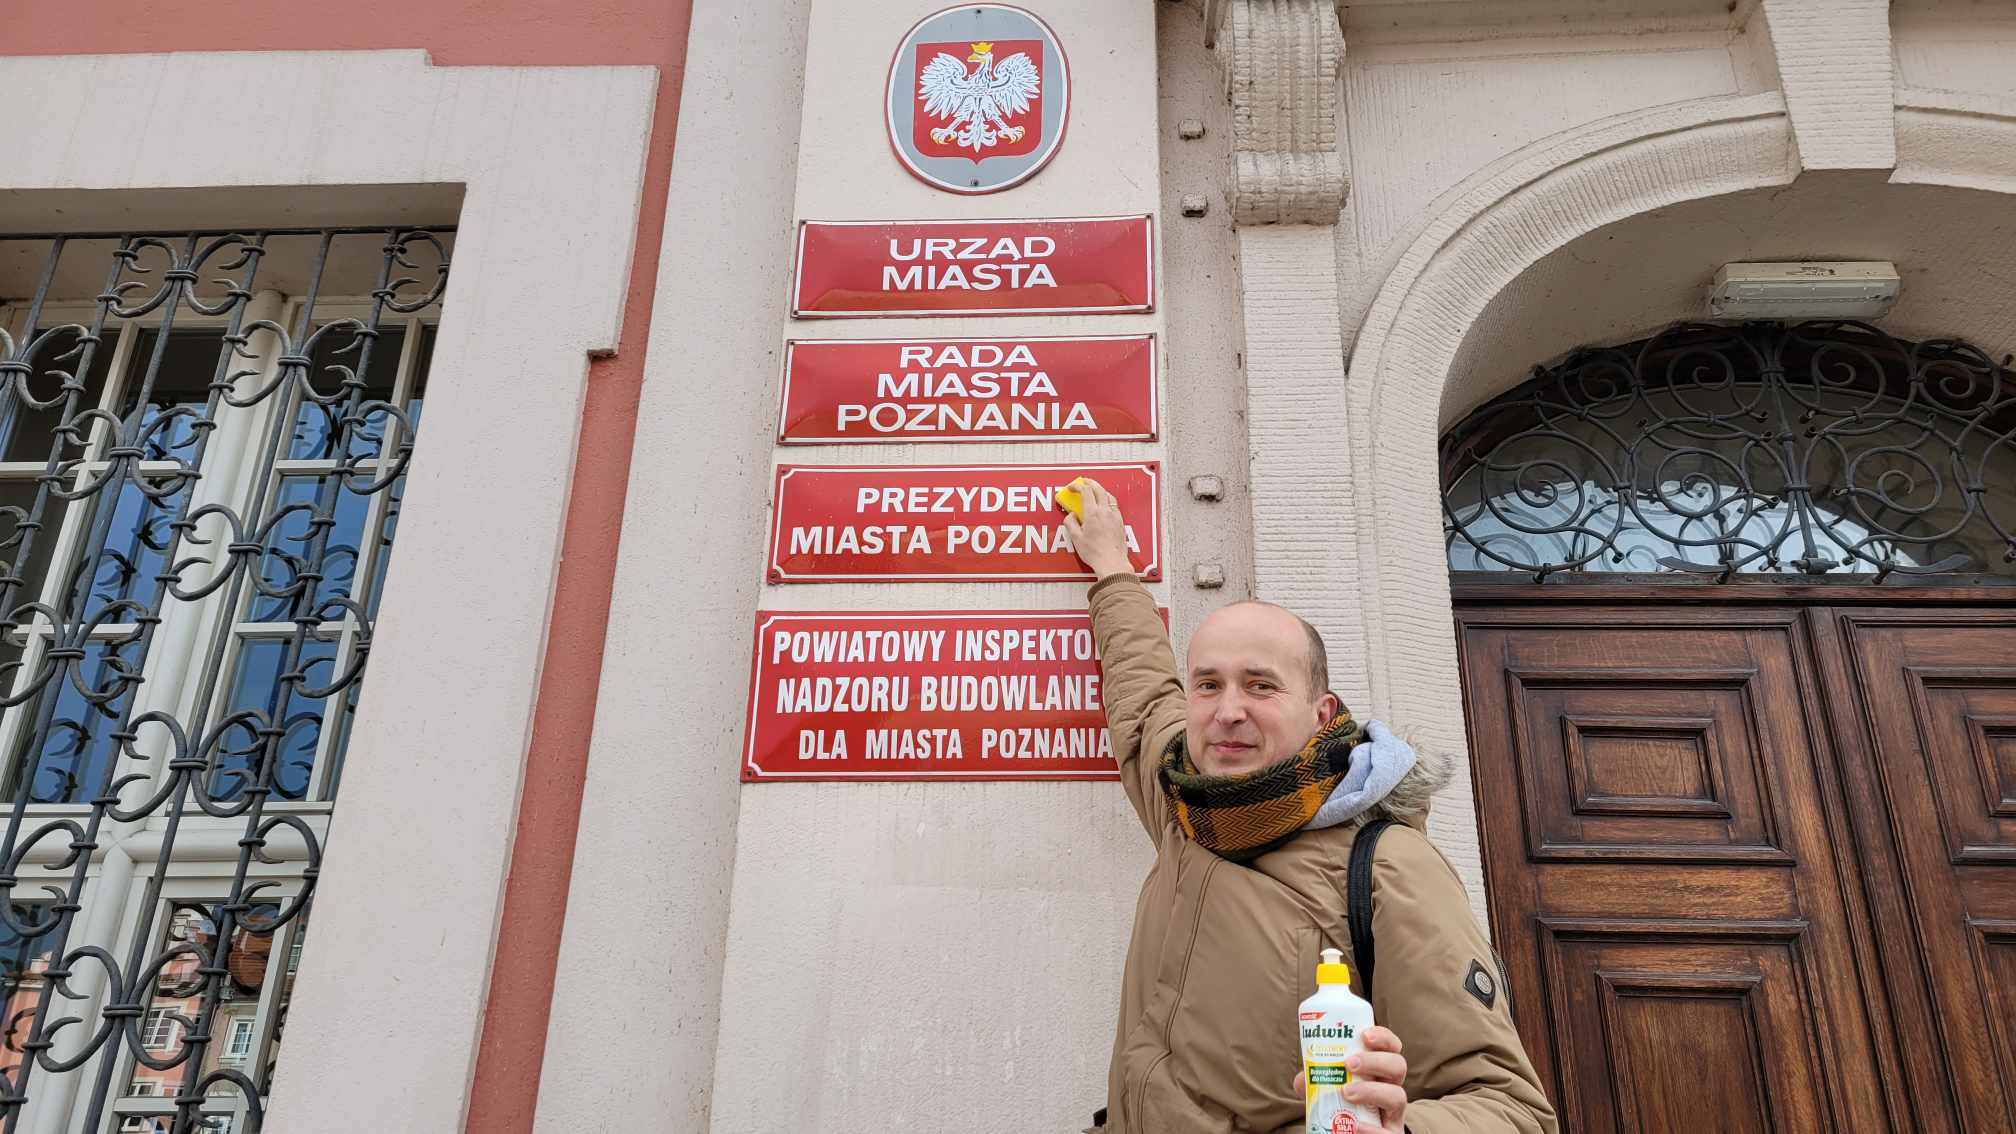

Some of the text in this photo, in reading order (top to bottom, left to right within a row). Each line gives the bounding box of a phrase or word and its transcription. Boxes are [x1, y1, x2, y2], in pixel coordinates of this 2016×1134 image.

[889, 236, 1056, 261] URZĄD
[882, 263, 1058, 290] MIASTA
[899, 345, 1038, 369] RADA
[876, 371, 1059, 398] MIASTA
[837, 401, 1098, 432] POZNANIA
[856, 485, 1066, 513] PREZYDEN
[789, 524, 1141, 555] MIASTA POZNAA
[772, 628, 1101, 664] POWIATOWY INSPEKTO
[776, 674, 1100, 714] NADZORU BUDOWLANE
[798, 727, 1114, 760] DLA MIASTA POZNANIA
